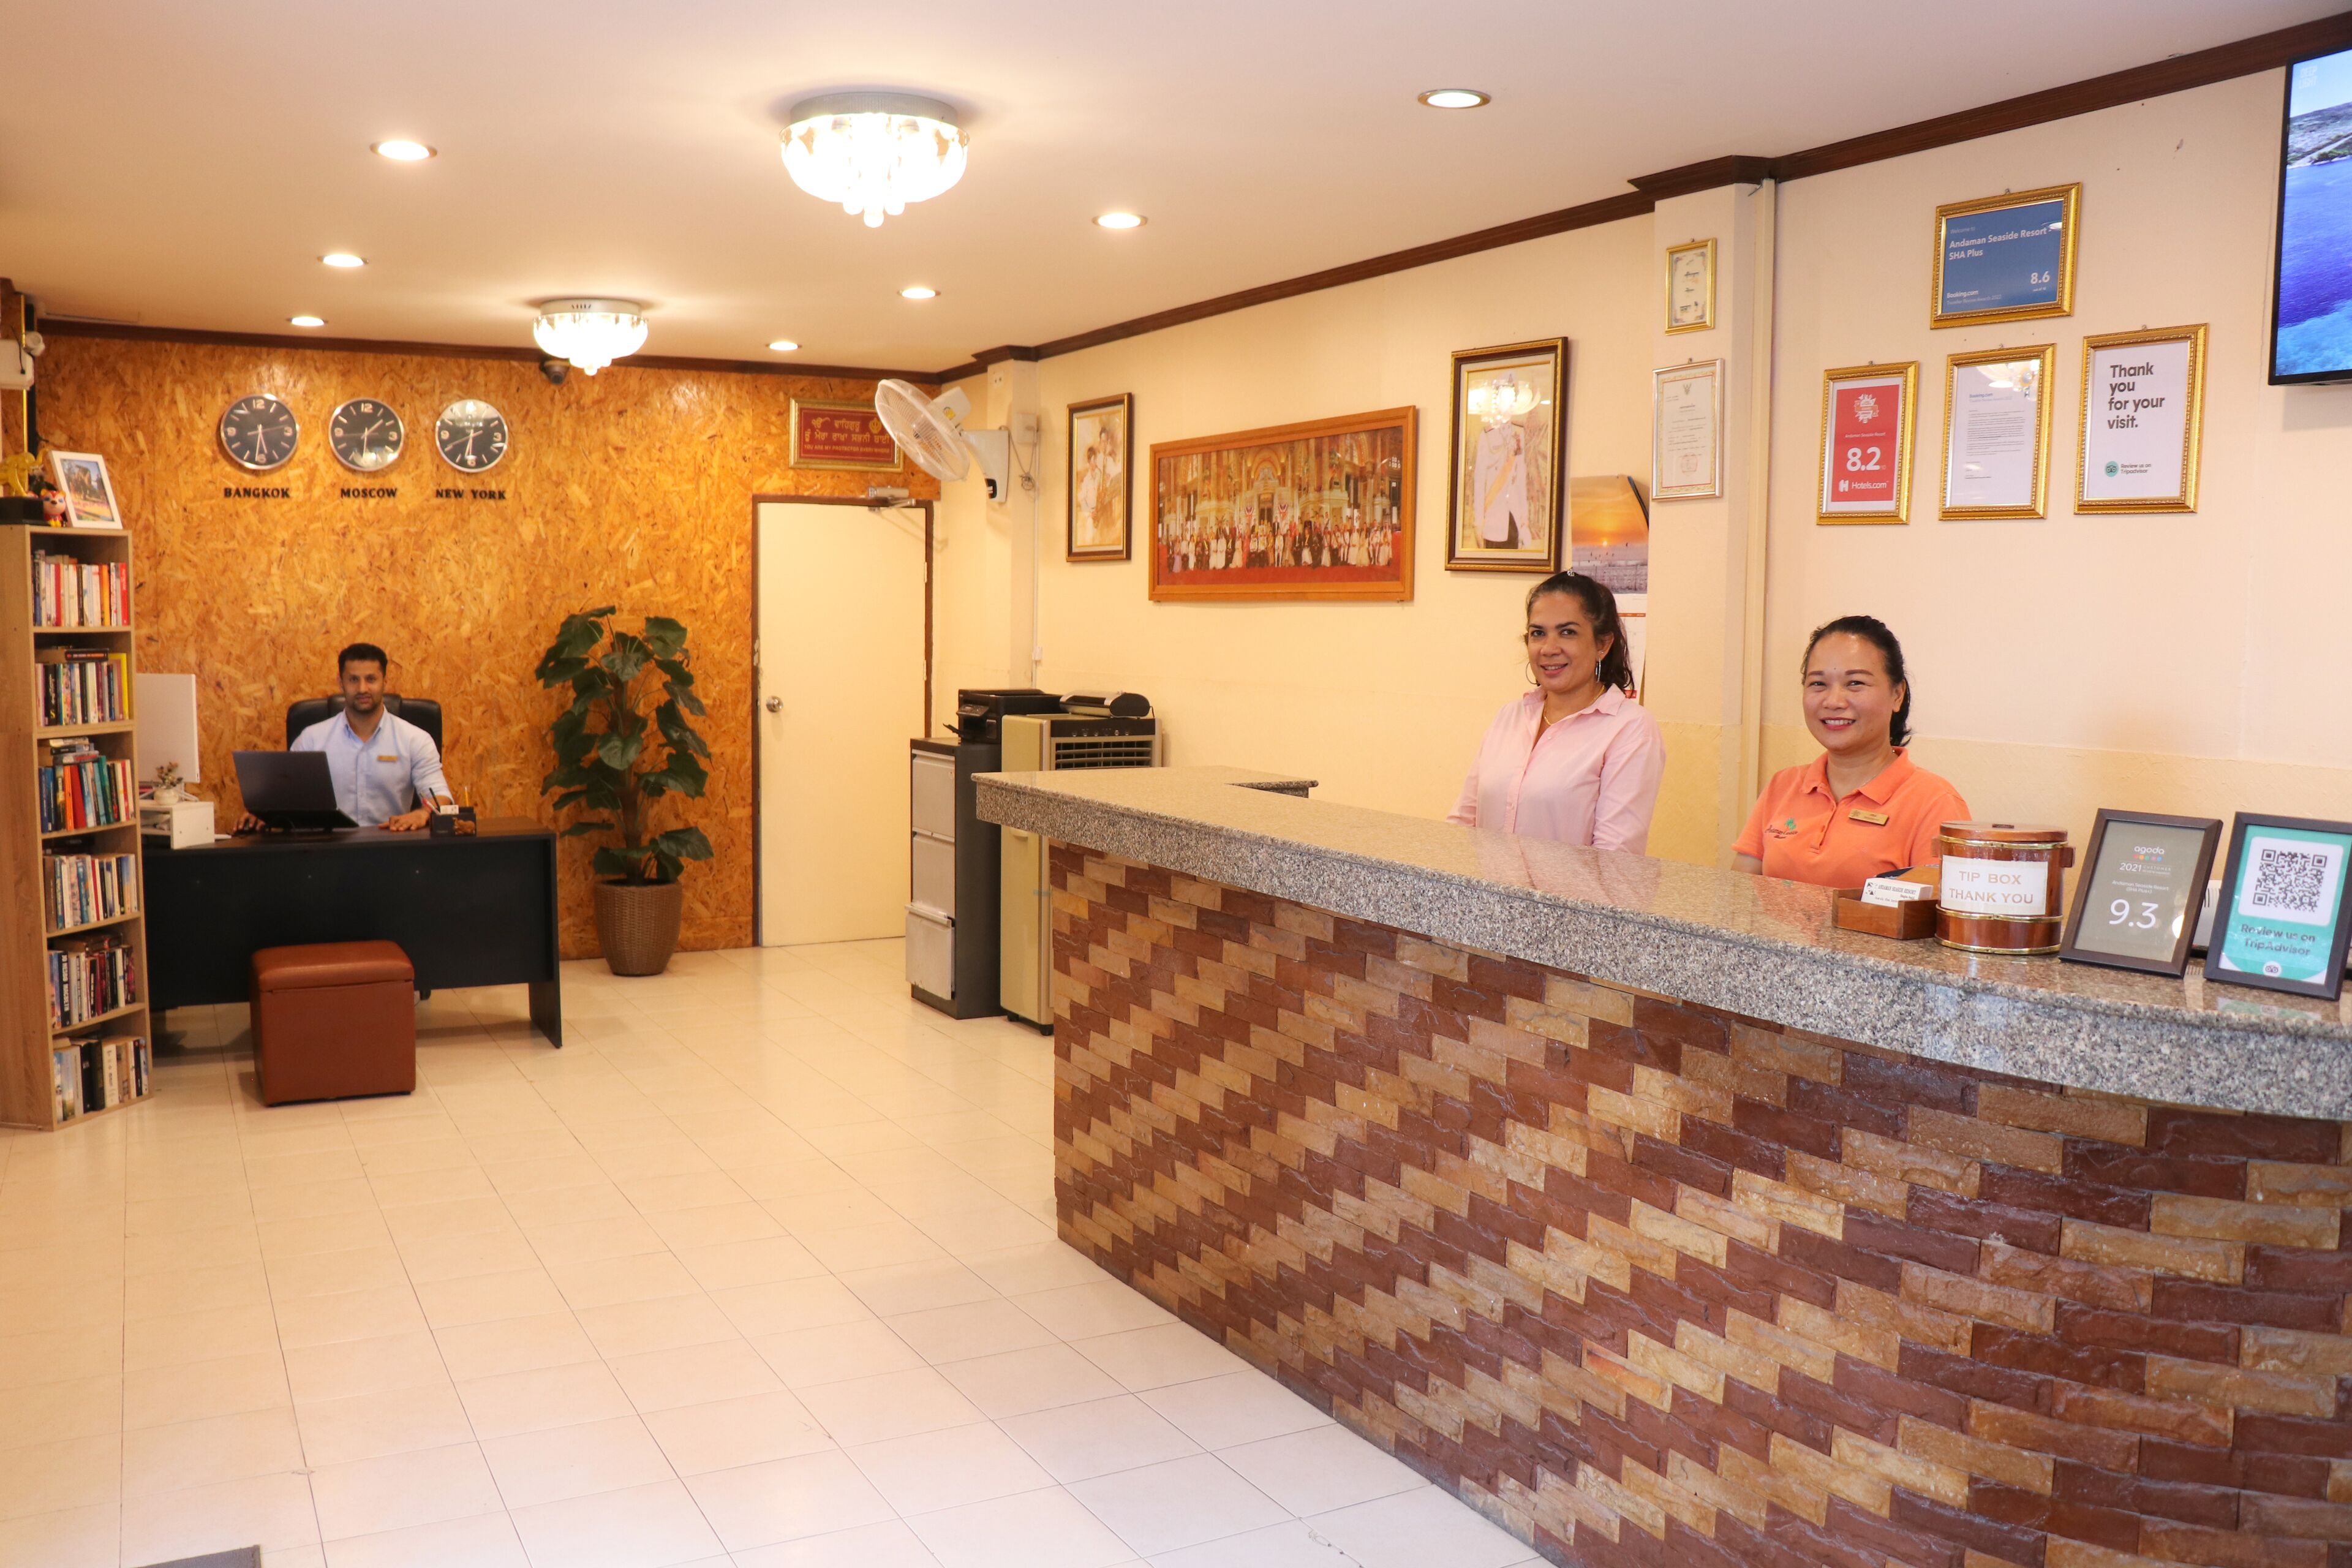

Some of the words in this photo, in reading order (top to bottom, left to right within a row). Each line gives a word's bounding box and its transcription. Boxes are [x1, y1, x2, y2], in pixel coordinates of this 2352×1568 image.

[1949, 238, 1986, 249] Andaman
[1988, 231, 2018, 243] Seaside
[2021, 227, 2047, 238] Resort
[1949, 250, 1966, 260] SHA
[1967, 248, 1983, 258] Plus
[2030, 271, 2050, 284] 8.6
[1947, 290, 1978, 298] Booking.com
[2110, 362, 2154, 378] Thank
[2109, 382, 2135, 396] you
[252, 399, 265, 410] 12
[361, 403, 374, 414] 12
[2108, 397, 2129, 411] for
[2133, 397, 2165, 412] your
[2108, 415, 2138, 429] visit.
[284, 427, 293, 437] 3
[388, 431, 398, 442] 3
[492, 432, 502, 442] 3
[1846, 447, 1881, 472] 8.2
[224, 488, 290, 498] BANGKOK
[341, 488, 398, 498] MOSCOW
[435, 488, 464, 499] NEW
[471, 489, 506, 500] YORK
[2134, 846, 2165, 854] agoda
[2119, 862, 2142, 872] 2021
[1959, 870, 1980, 882] TIP
[1988, 873, 2022, 884] BOX
[1949, 888, 1996, 902] THANK
[2001, 893, 2034, 904] YOU
[2109, 899, 2158, 929] 9.3
[2241, 923, 2283, 938] Review
[2286, 932, 2298, 940] us
[2301, 933, 2316, 943] on
[2244, 938, 2310, 956] TripAdvisor
